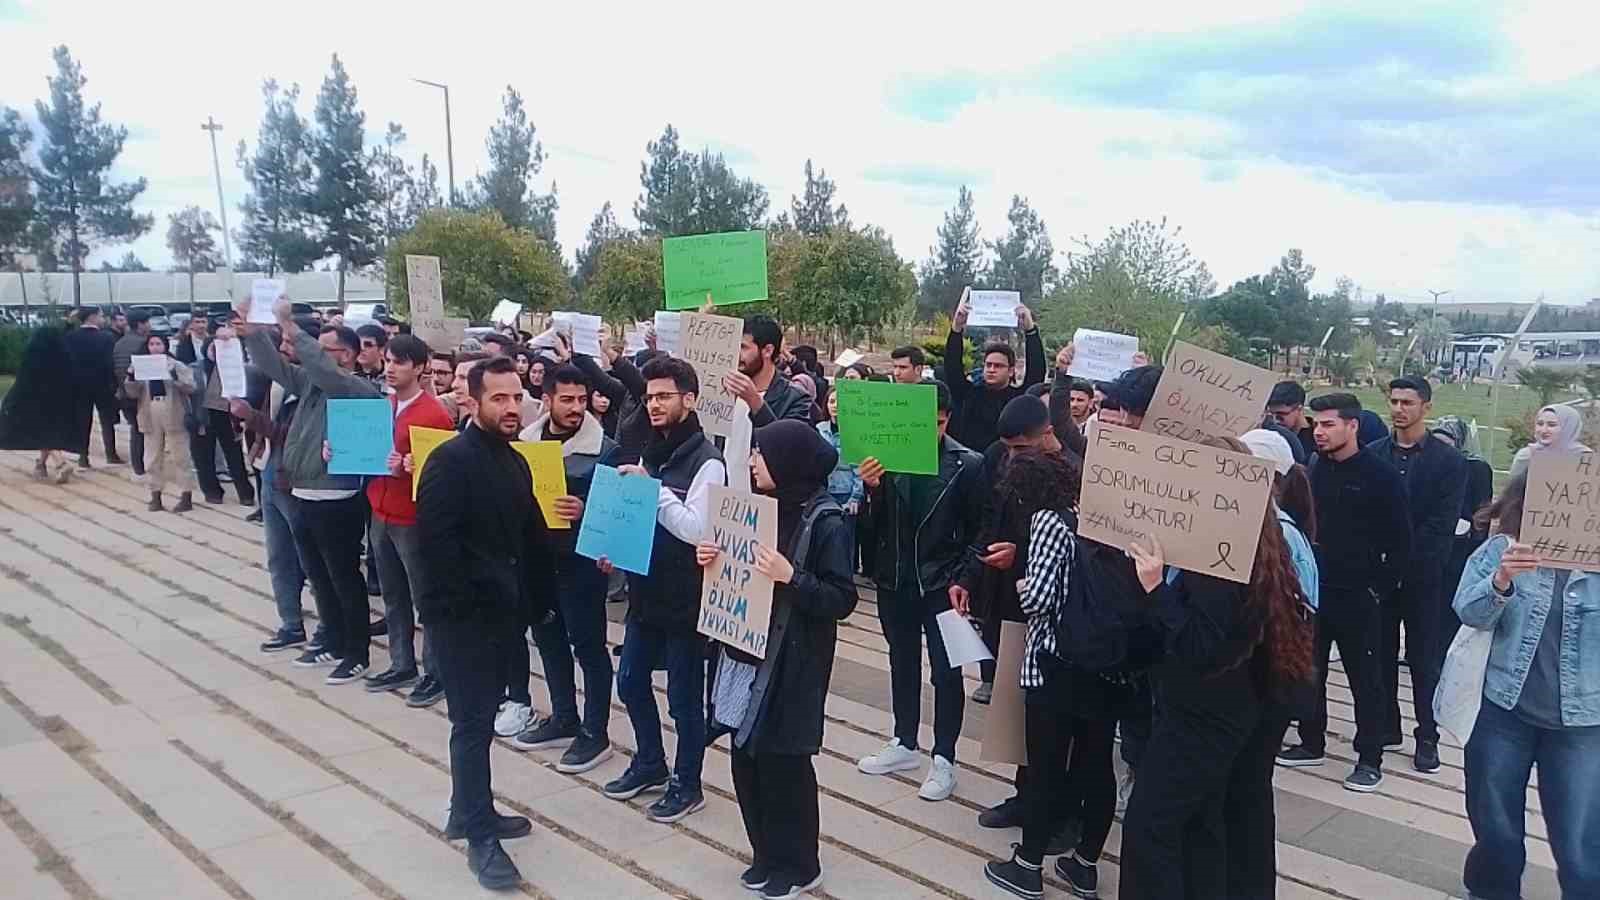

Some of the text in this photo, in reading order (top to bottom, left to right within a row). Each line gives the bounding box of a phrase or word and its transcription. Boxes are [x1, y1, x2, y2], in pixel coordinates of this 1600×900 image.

[1087, 463, 1241, 515] SORUMLULUK DA
[1215, 454, 1271, 488] YOKSA
[719, 496, 760, 533] BİLİM
[1123, 498, 1194, 534] YOKTUR!
[1527, 509, 1572, 529] TÜM
[713, 525, 760, 566] YUVAS
[708, 580, 749, 623] ÖLÜM
[701, 607, 740, 641] YUVASI
